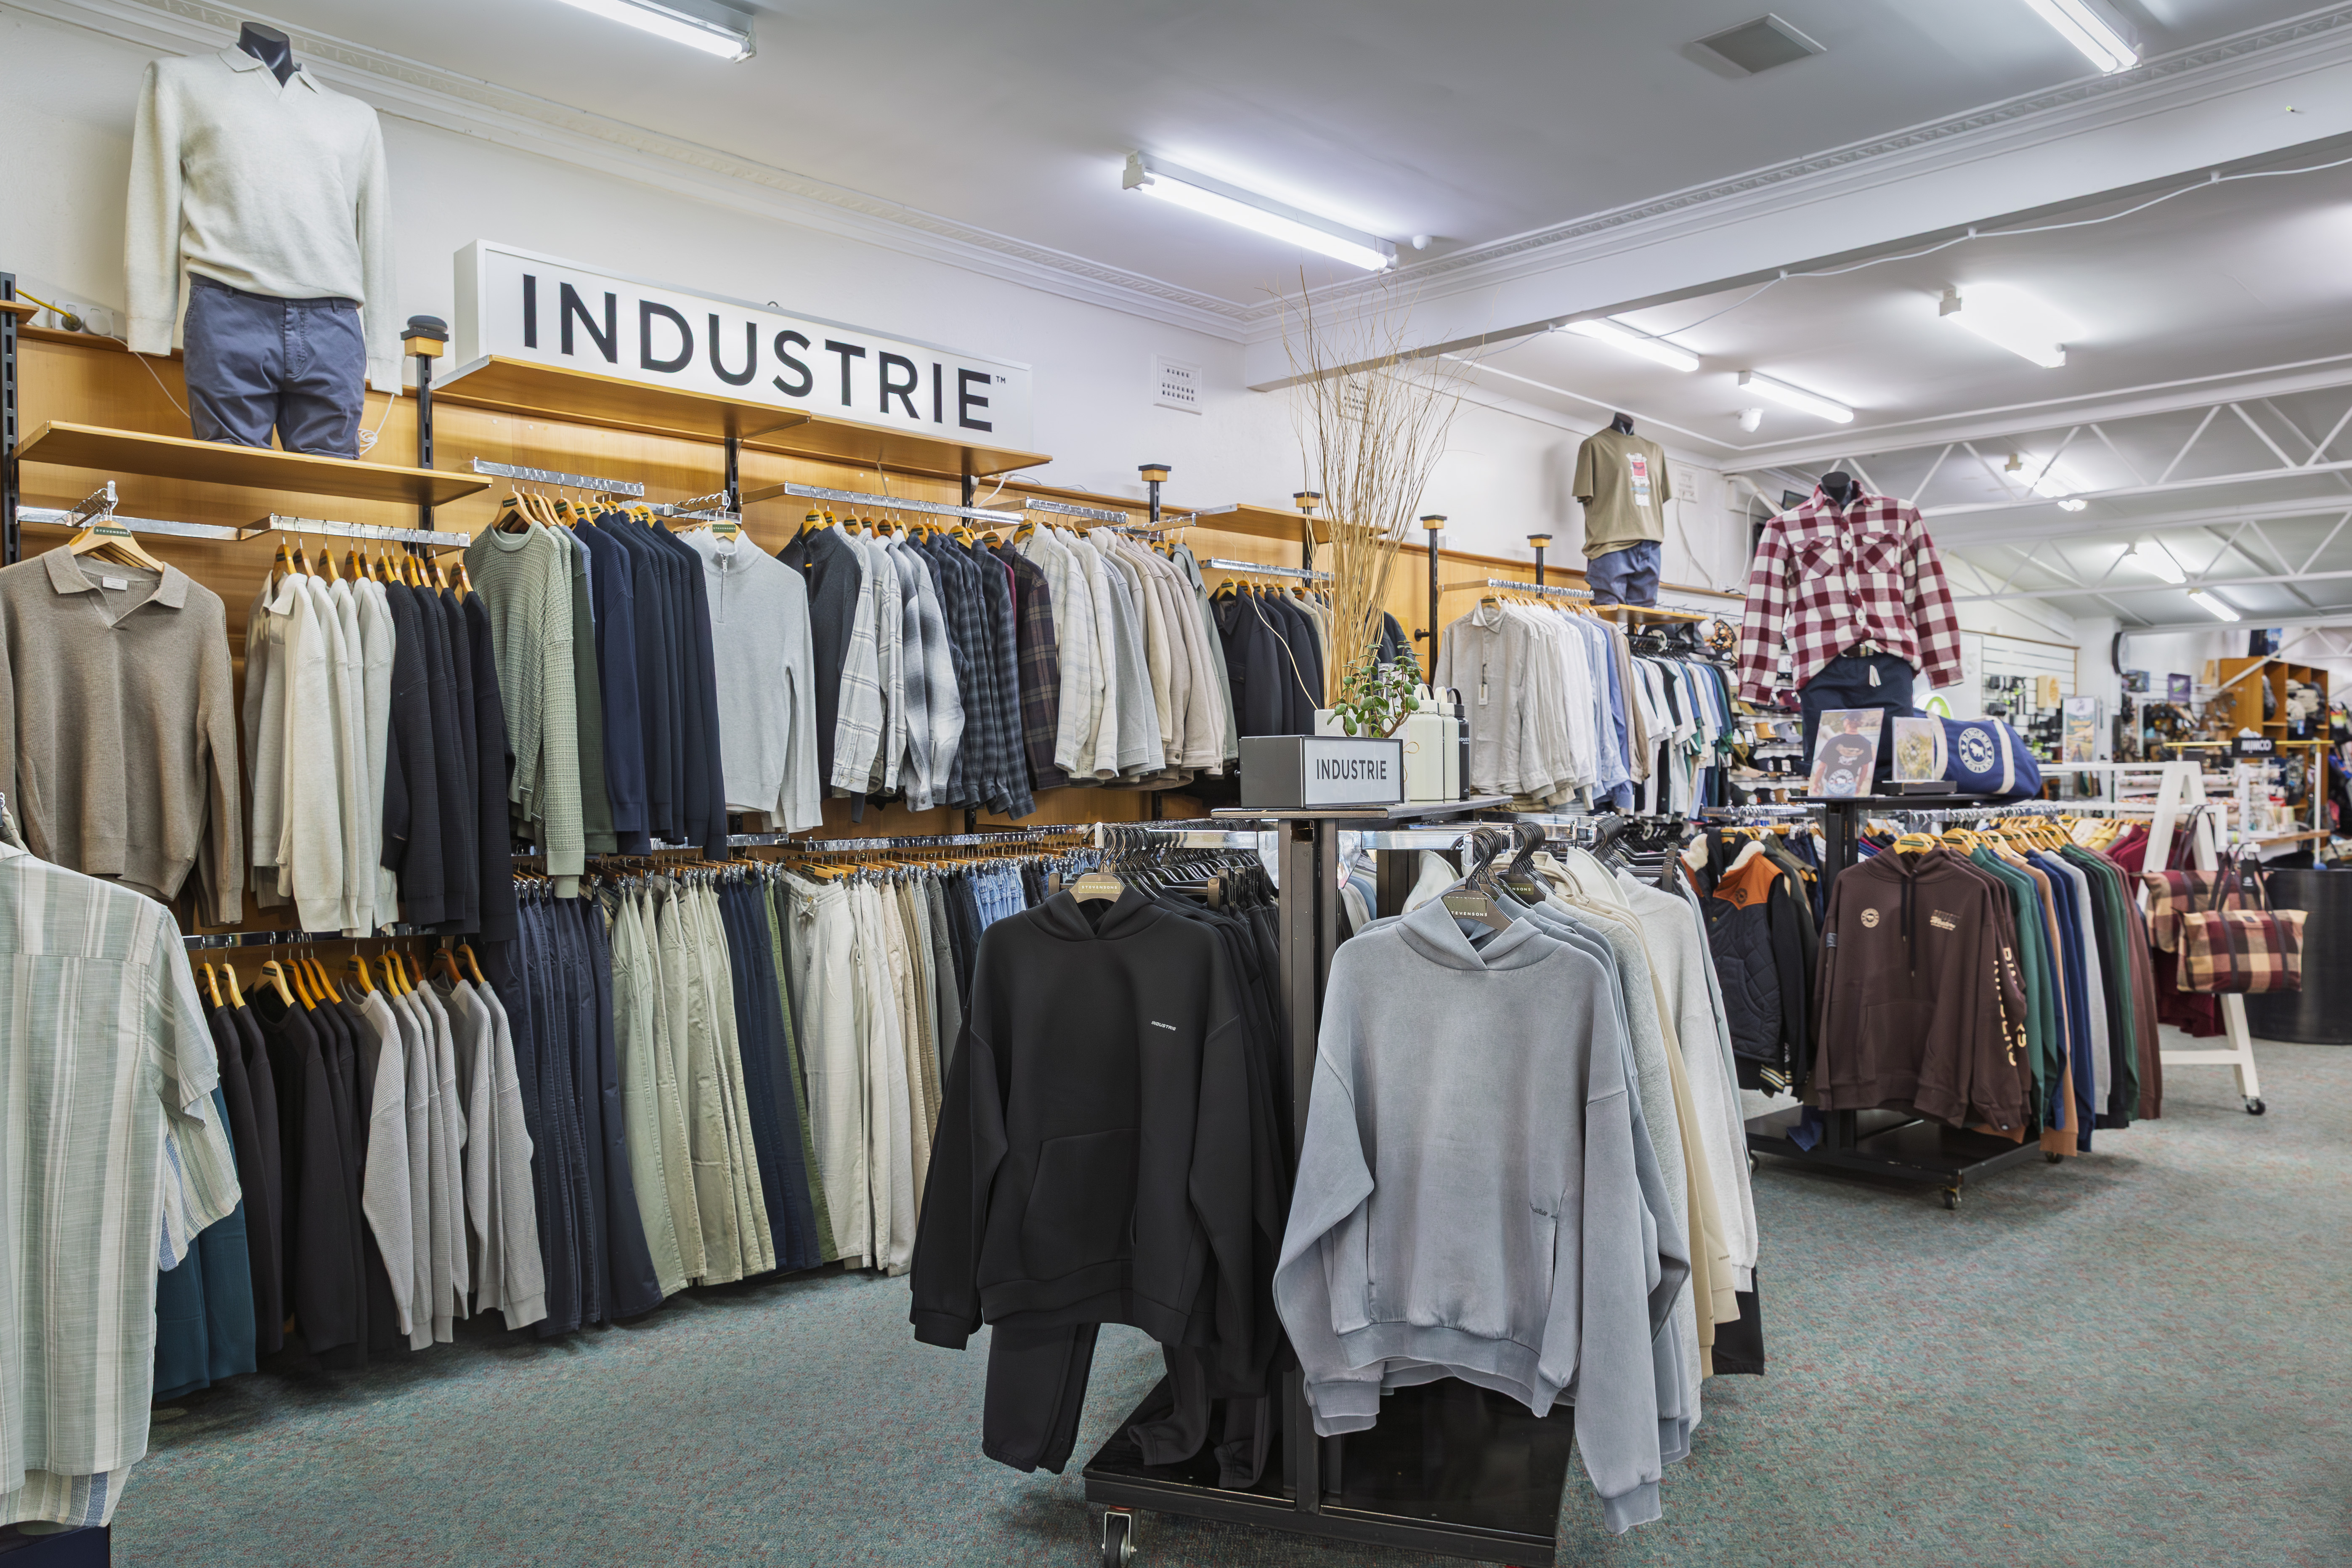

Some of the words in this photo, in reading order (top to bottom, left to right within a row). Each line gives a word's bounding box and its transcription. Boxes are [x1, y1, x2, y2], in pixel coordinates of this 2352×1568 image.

[523, 273, 993, 432] INDUSTRIE
[1317, 759, 1387, 780] INDUSTRIE
[1151, 1021, 1176, 1031] INDUSTRIE
